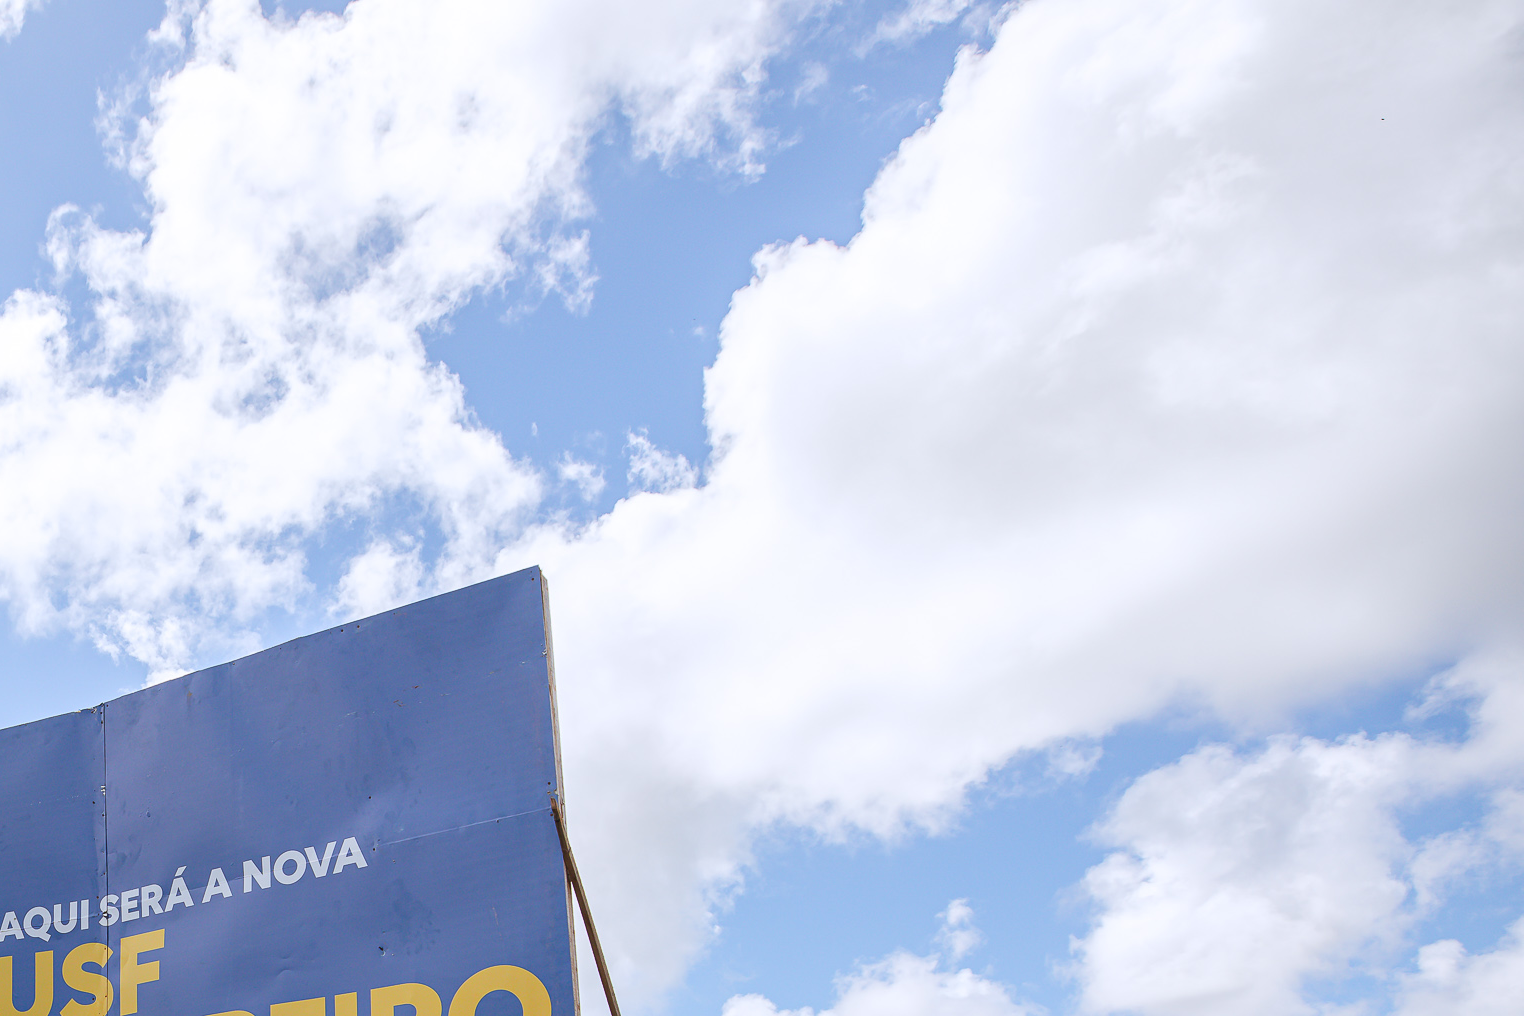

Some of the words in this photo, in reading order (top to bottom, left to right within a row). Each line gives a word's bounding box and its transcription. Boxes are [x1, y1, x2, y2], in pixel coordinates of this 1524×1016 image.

[98, 865, 195, 927] SERÁ
[201, 867, 233, 904] A
[242, 836, 368, 894] NOVA
